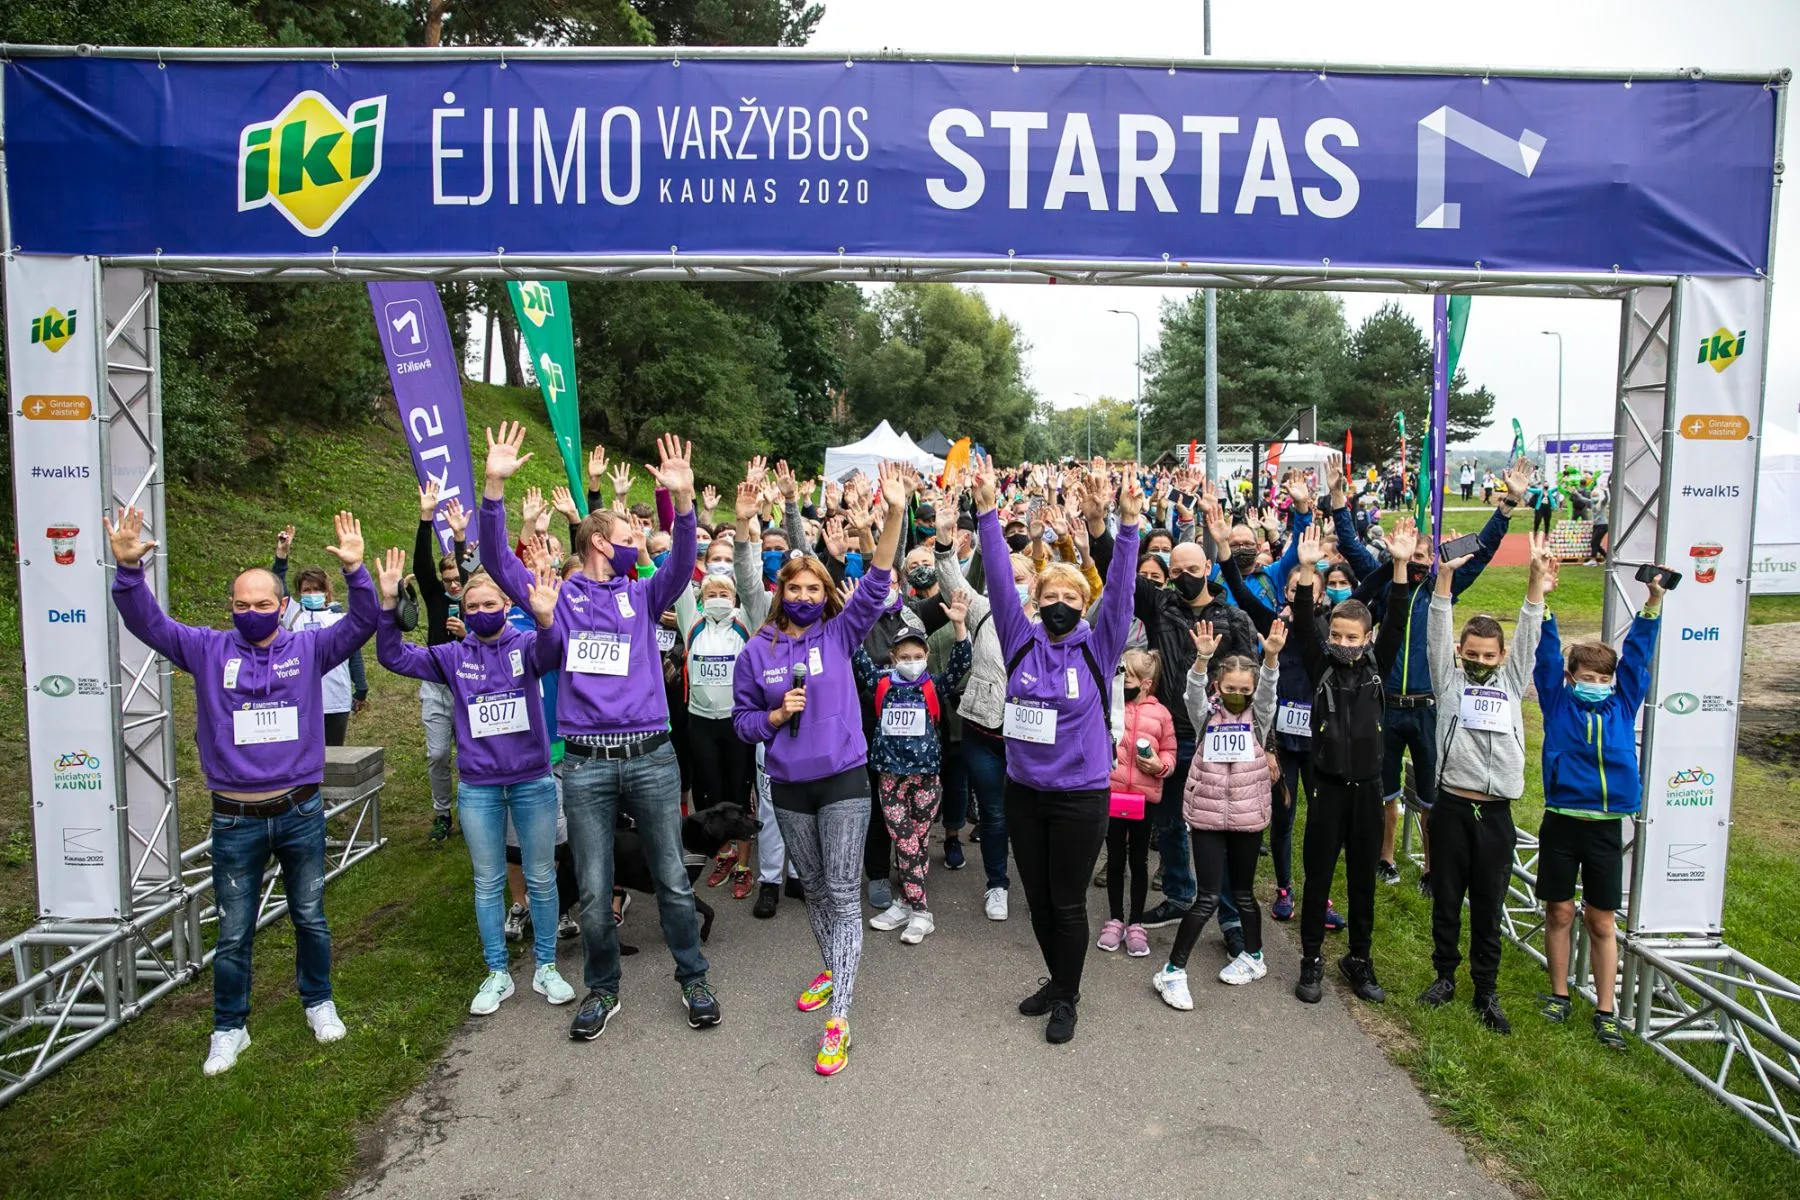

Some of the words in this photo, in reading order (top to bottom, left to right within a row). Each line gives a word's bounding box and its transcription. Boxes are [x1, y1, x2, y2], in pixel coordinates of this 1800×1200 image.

[244, 102, 379, 203] iki
[432, 91, 641, 206] ĖJIMO
[656, 96, 869, 161] VARŽYBOS
[925, 108, 1360, 219] STARTAS
[659, 178, 777, 204] KAUNAS
[798, 178, 869, 204] 2020
[31, 308, 77, 344] iki
[1697, 329, 1747, 364] iki
[31, 464, 90, 479] #walk15
[1681, 484, 1740, 498] #walk15
[1751, 556, 1797, 573] ctivus
[48, 608, 86, 624] Delfi
[657, 631, 674, 644] 259
[1681, 626, 1720, 641] Delfi
[577, 641, 620, 662] 8076
[276, 668, 300, 679] Yordan
[700, 663, 728, 678] 0453
[479, 701, 516, 723] 8077
[1474, 698, 1502, 714] 0817
[254, 711, 277, 726] 1111
[887, 710, 916, 726] 0907
[1015, 707, 1044, 726] 9000
[1286, 709, 1309, 727] 019
[1212, 734, 1246, 752] 0190
[54, 772, 102, 782] iniciatyvos
[55, 779, 102, 790] KAUNUI
[1666, 788, 1714, 798] iniciatyvos
[1666, 795, 1713, 807] KAUNUI
